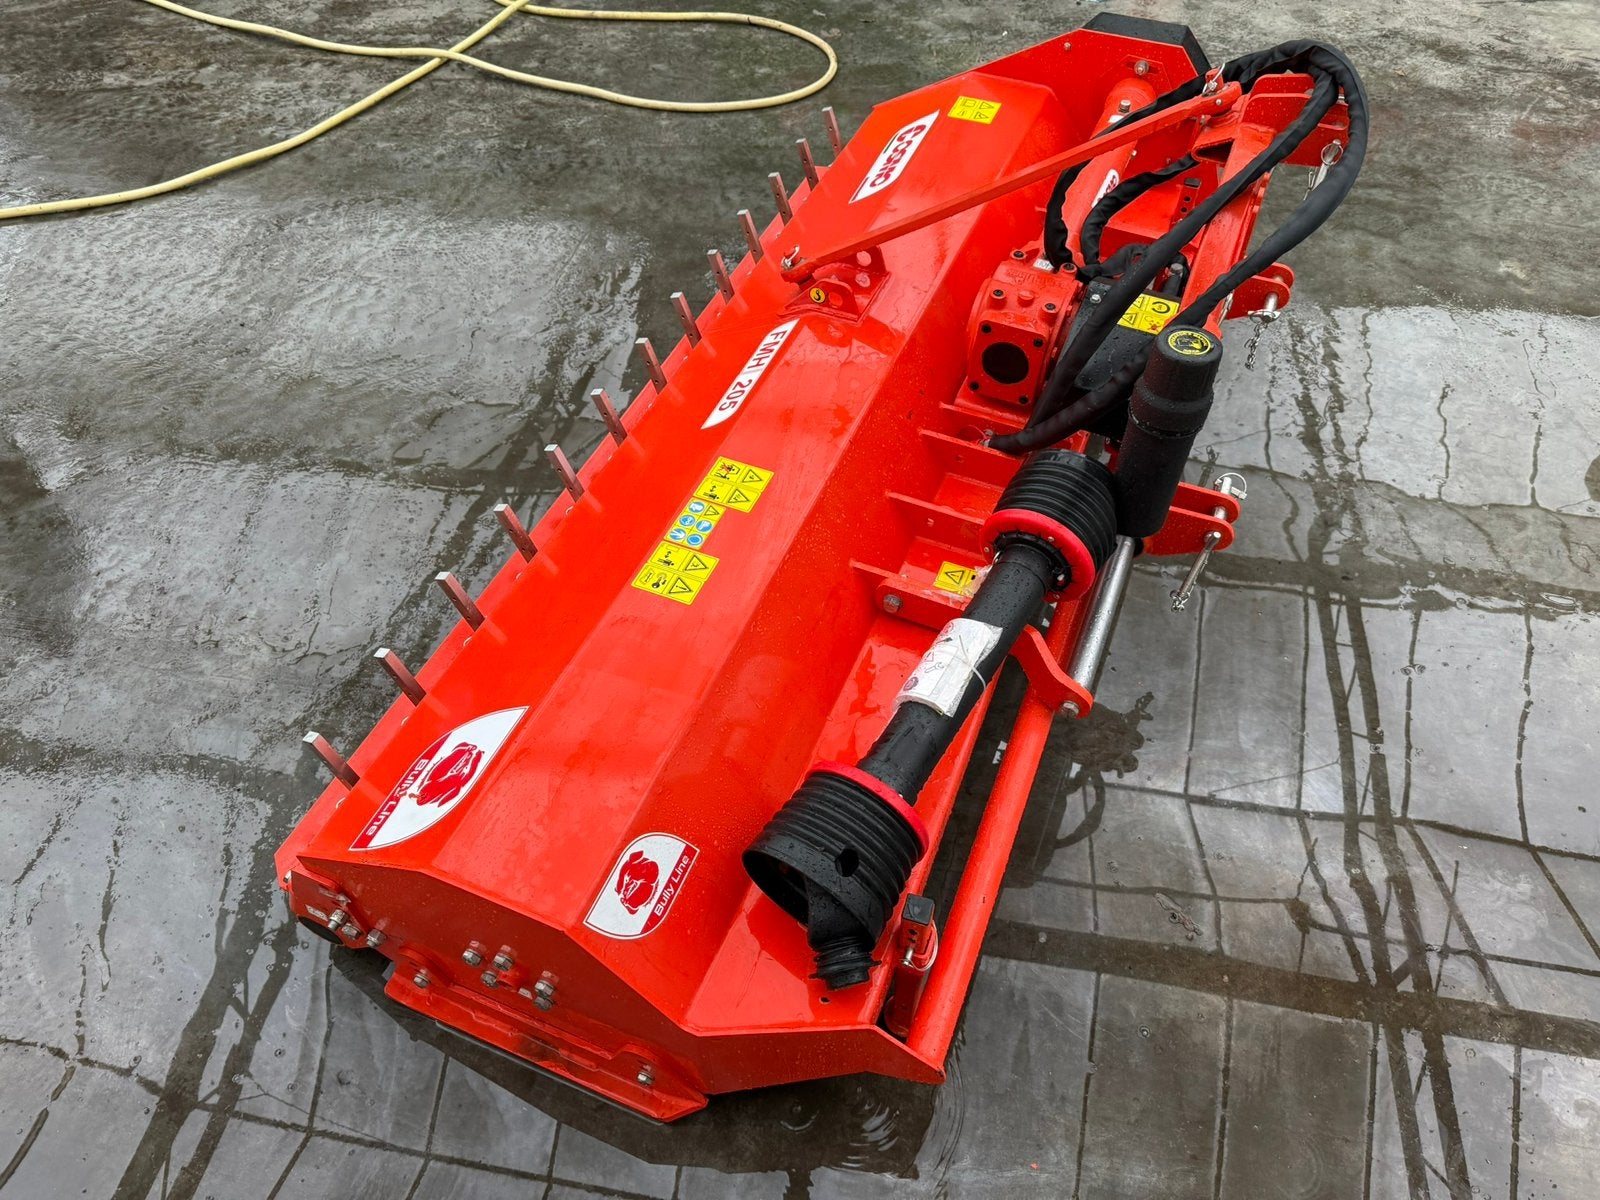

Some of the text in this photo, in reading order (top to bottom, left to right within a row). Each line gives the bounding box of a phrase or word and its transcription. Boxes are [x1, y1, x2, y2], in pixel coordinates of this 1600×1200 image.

[718, 330, 788, 412] FMH 205
[366, 800, 397, 836] Line
[653, 855, 690, 917] Bully Line
